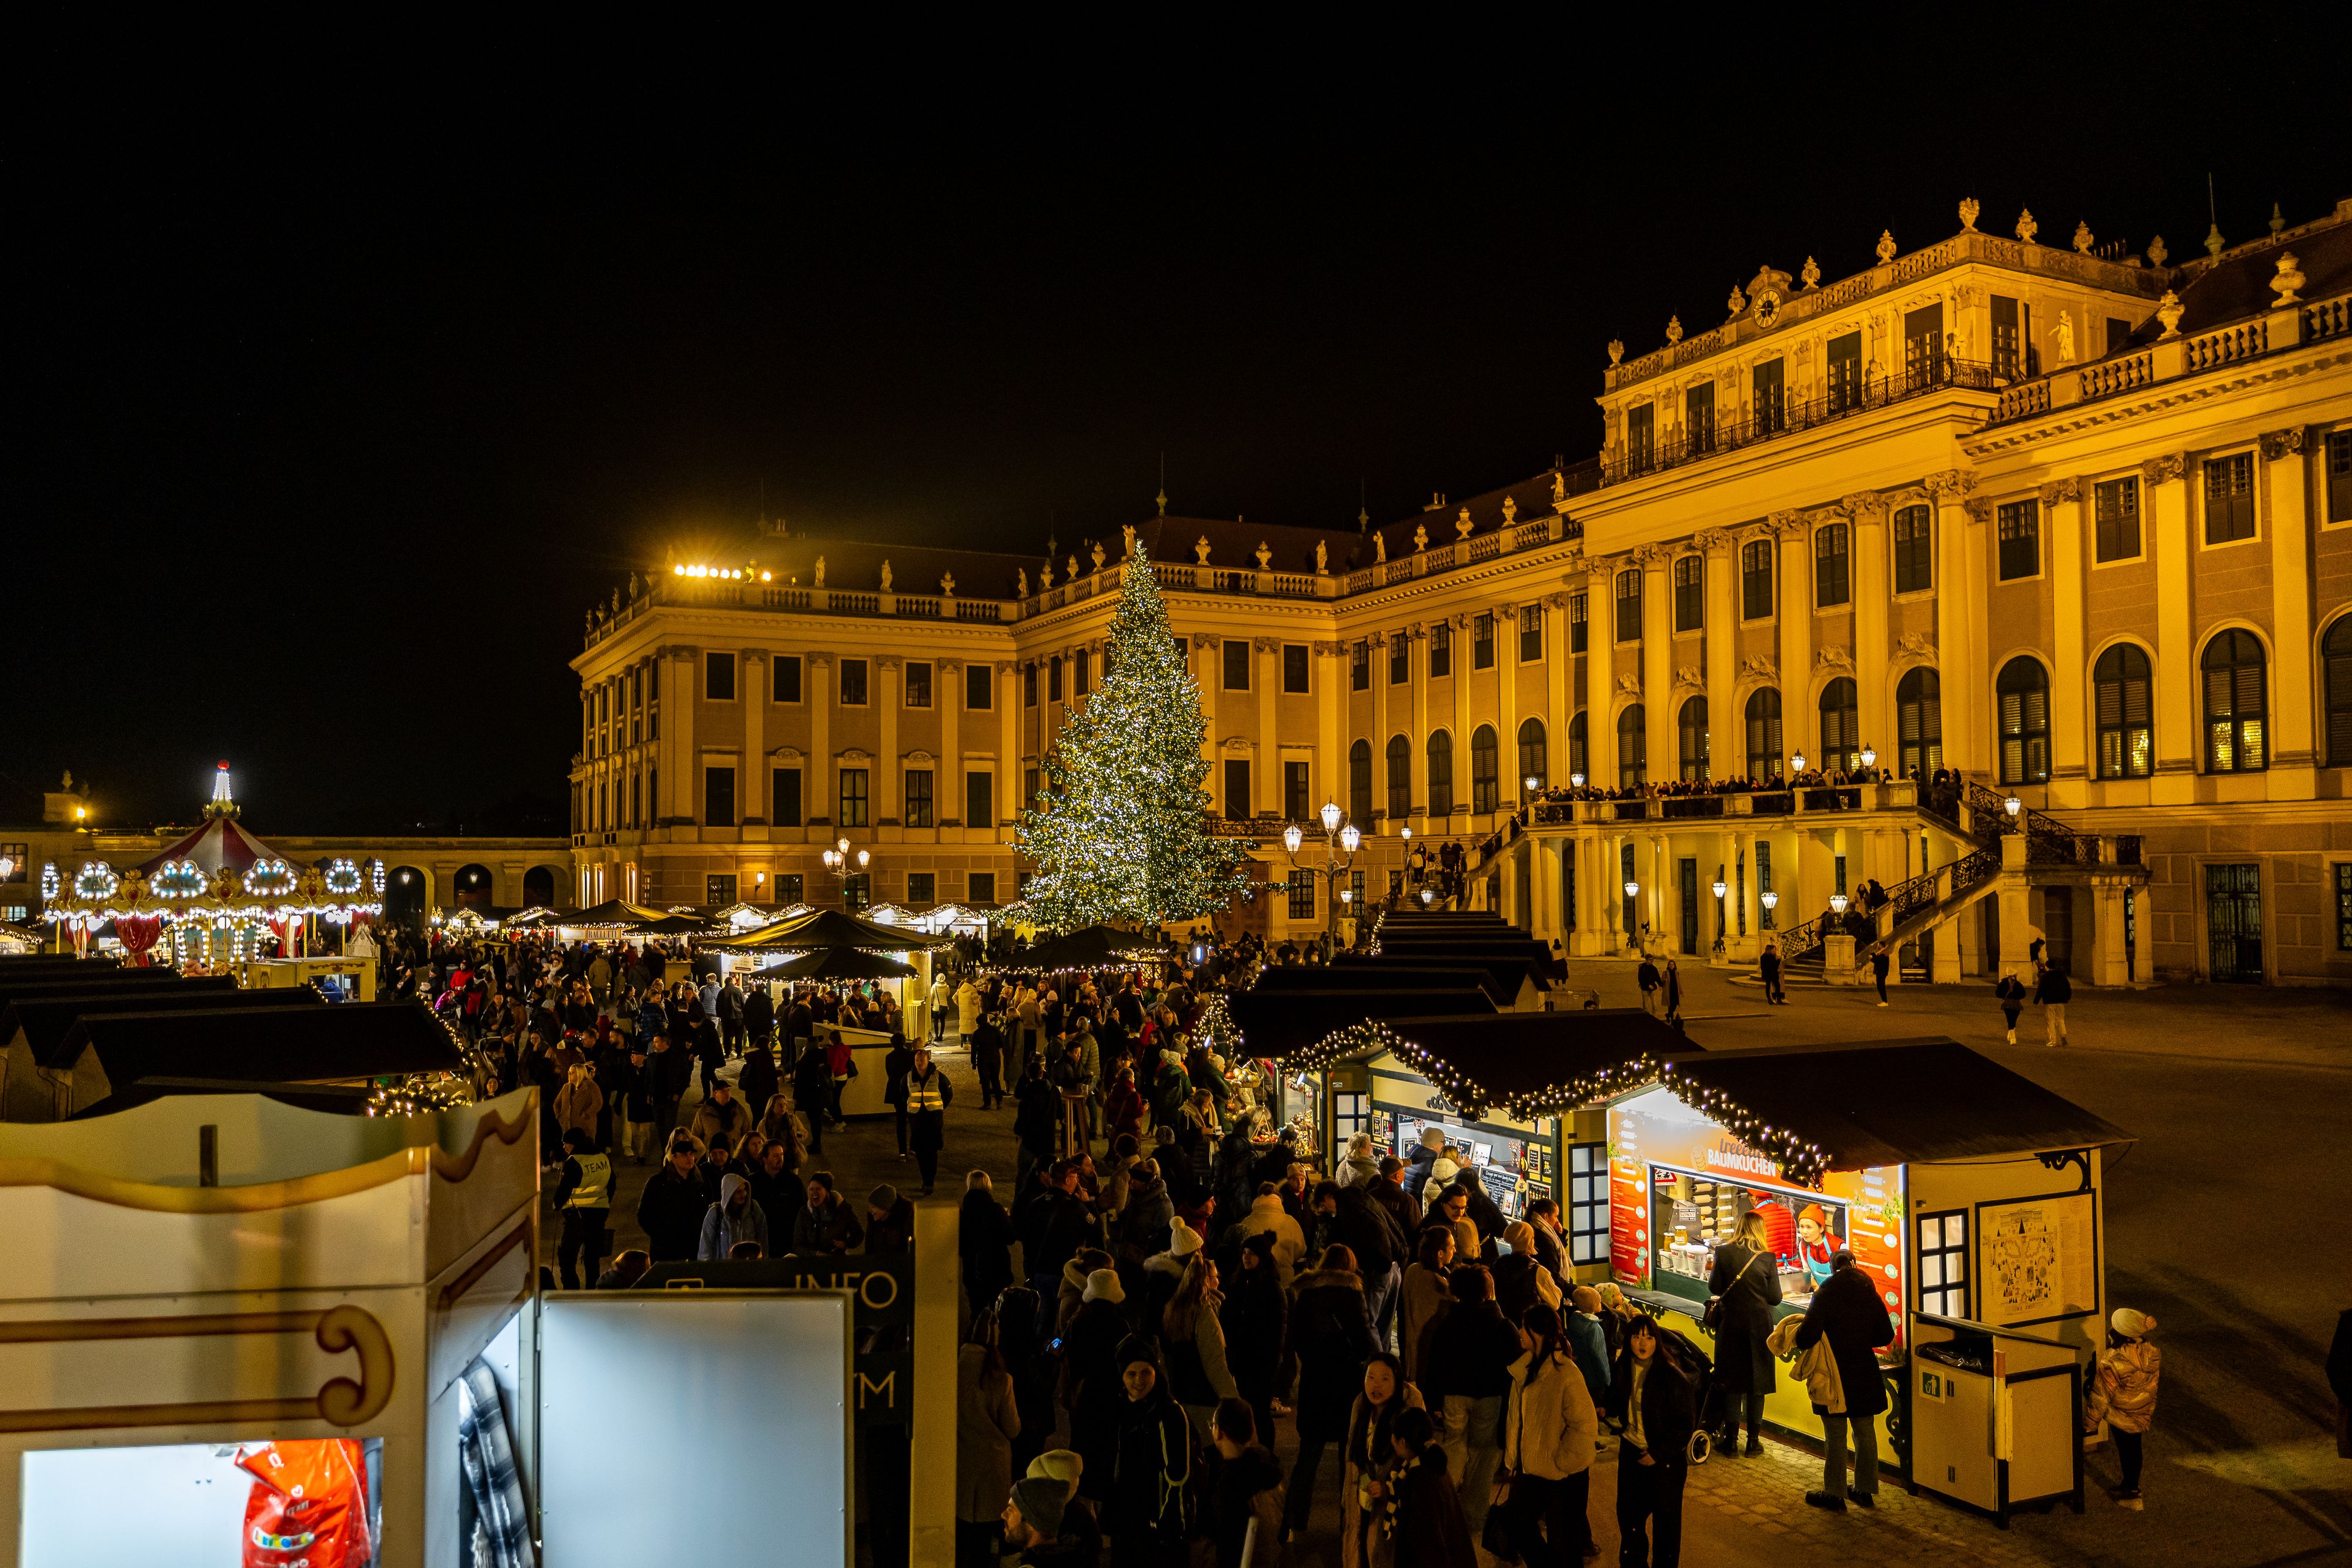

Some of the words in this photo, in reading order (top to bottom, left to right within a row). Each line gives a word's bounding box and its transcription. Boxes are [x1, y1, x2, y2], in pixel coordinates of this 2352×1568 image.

[584, 1160, 609, 1174] TEAM
[1708, 1148, 1776, 1177] BAUMKUCHEN
[1885, 1293, 1895, 1303] 8,50
